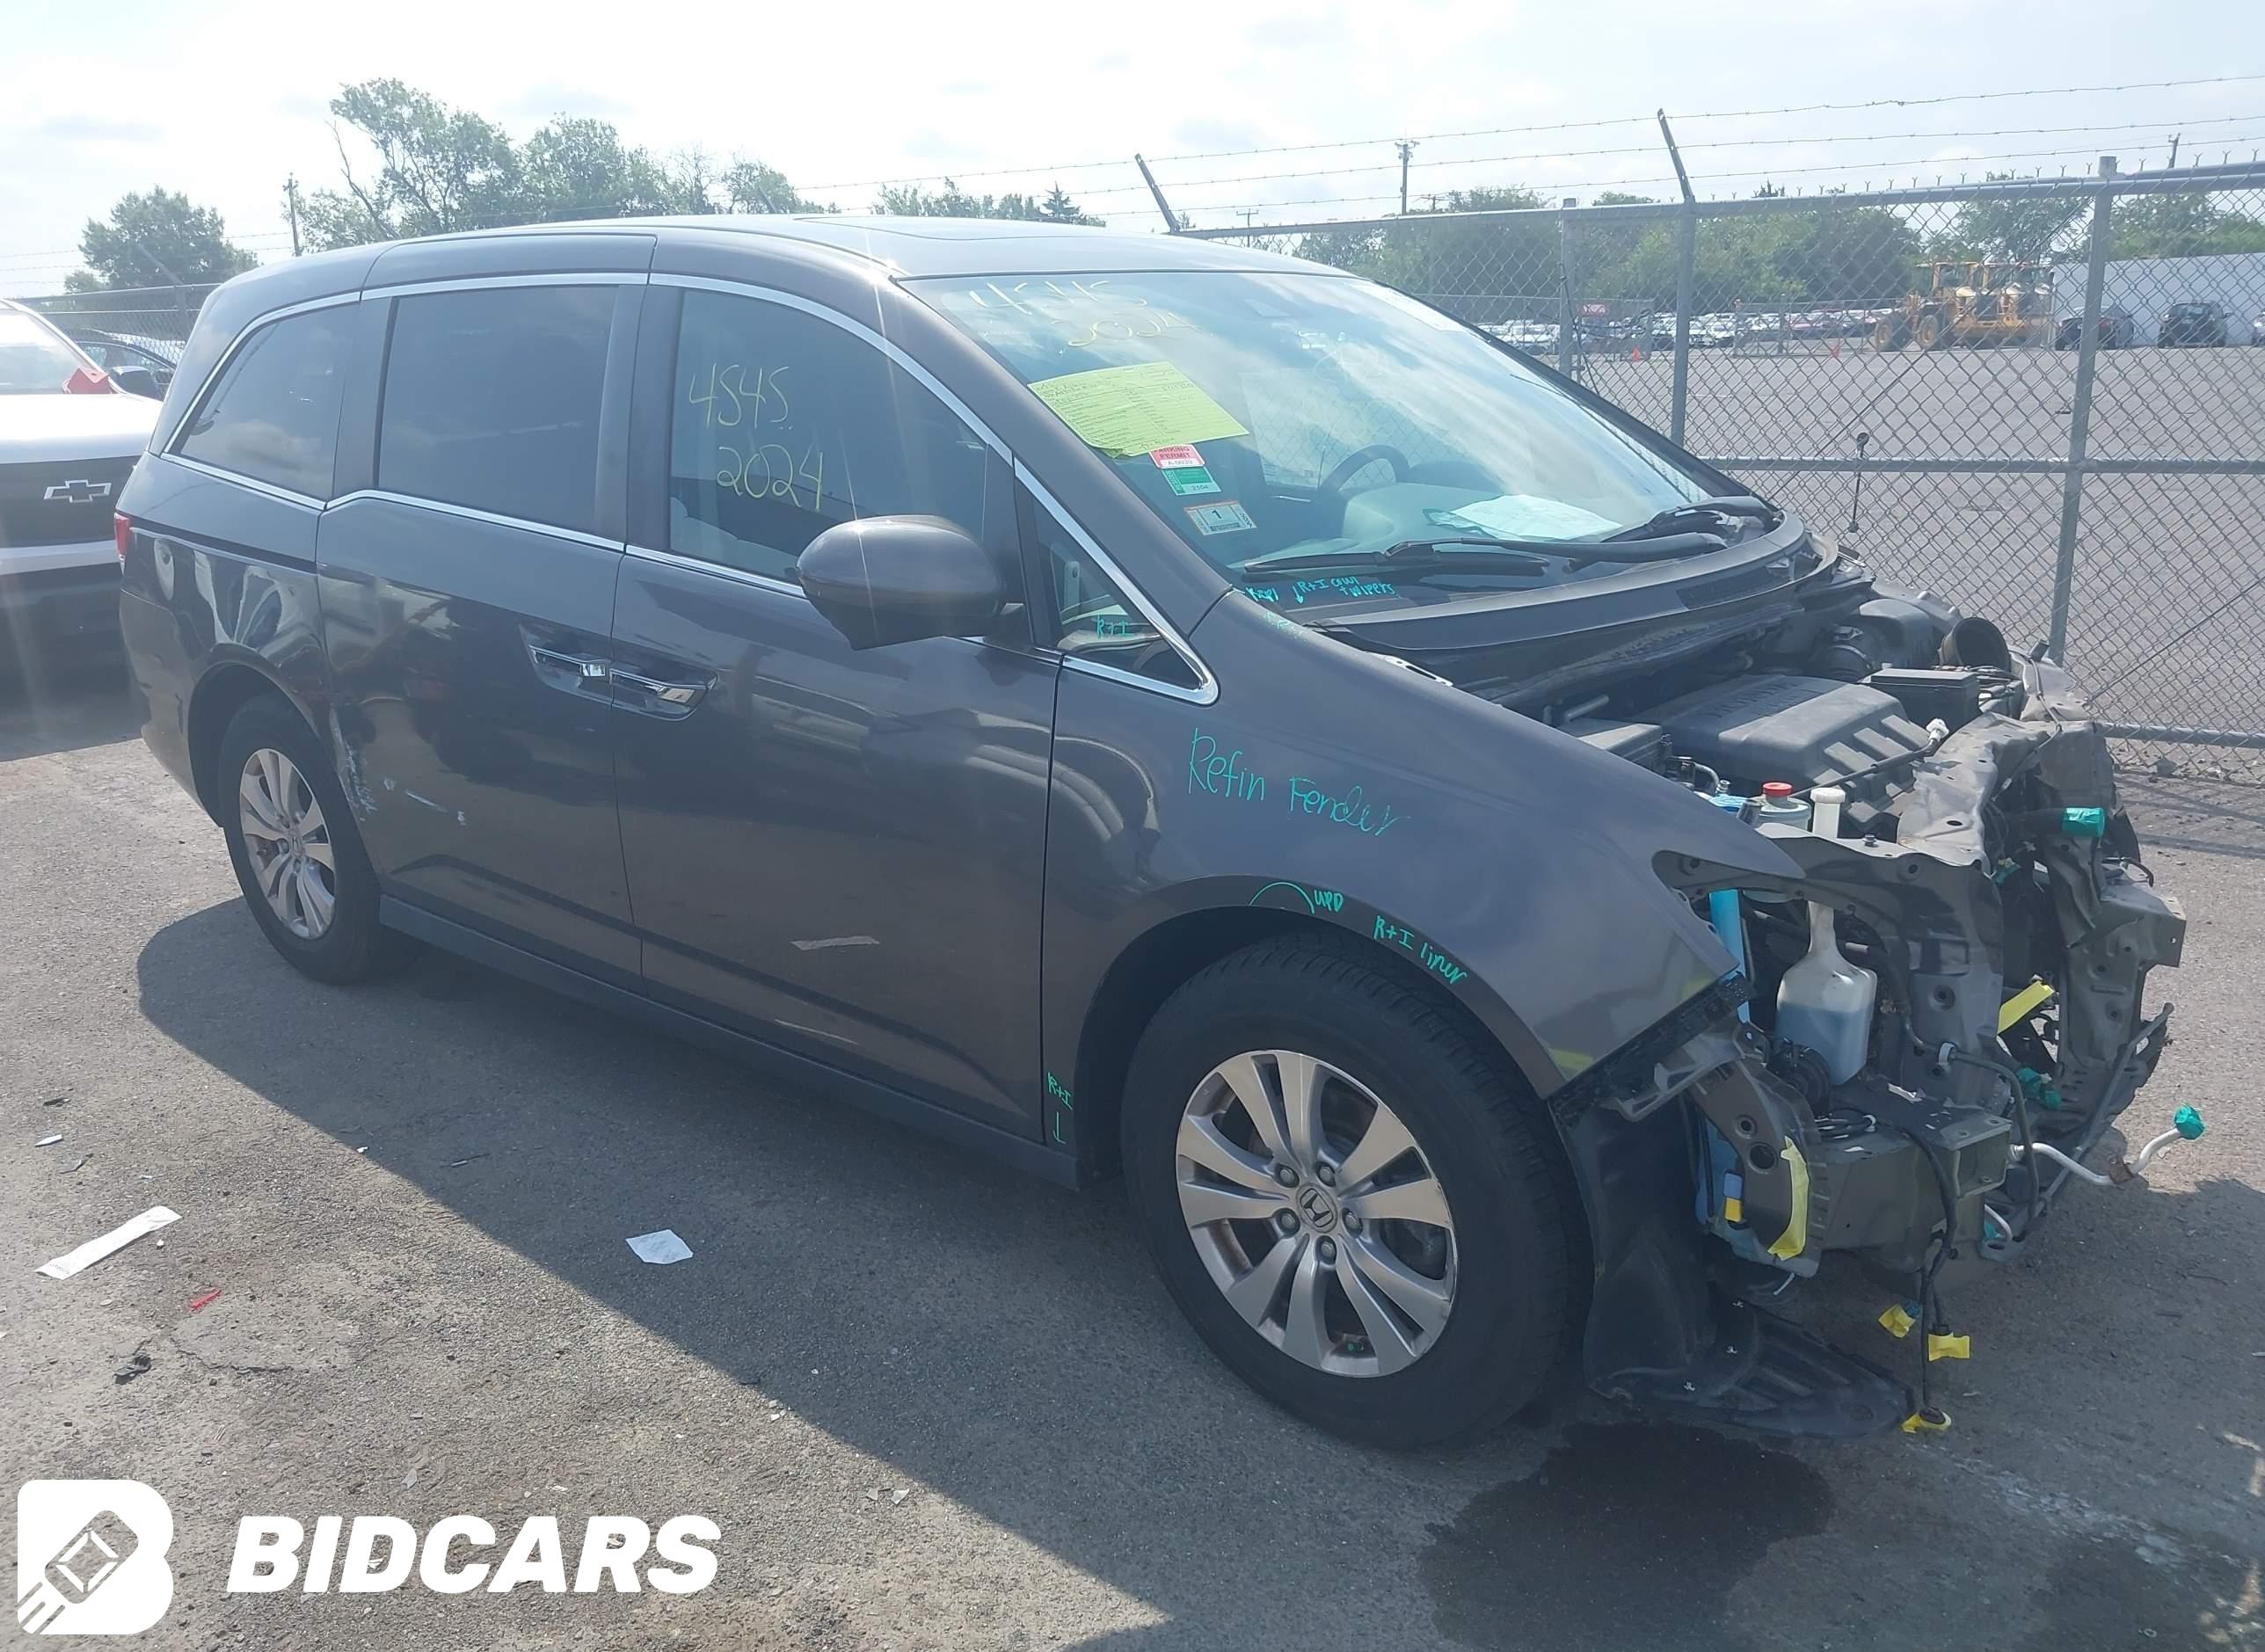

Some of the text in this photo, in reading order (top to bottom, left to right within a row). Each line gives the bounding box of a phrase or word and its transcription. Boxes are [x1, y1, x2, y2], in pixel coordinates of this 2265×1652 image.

[689, 363, 790, 429] 4545
[717, 443, 825, 513] 2024
[1212, 510, 1222, 520] 1
[1187, 728, 1265, 801] Refin
[1373, 915, 1415, 950] R+I
